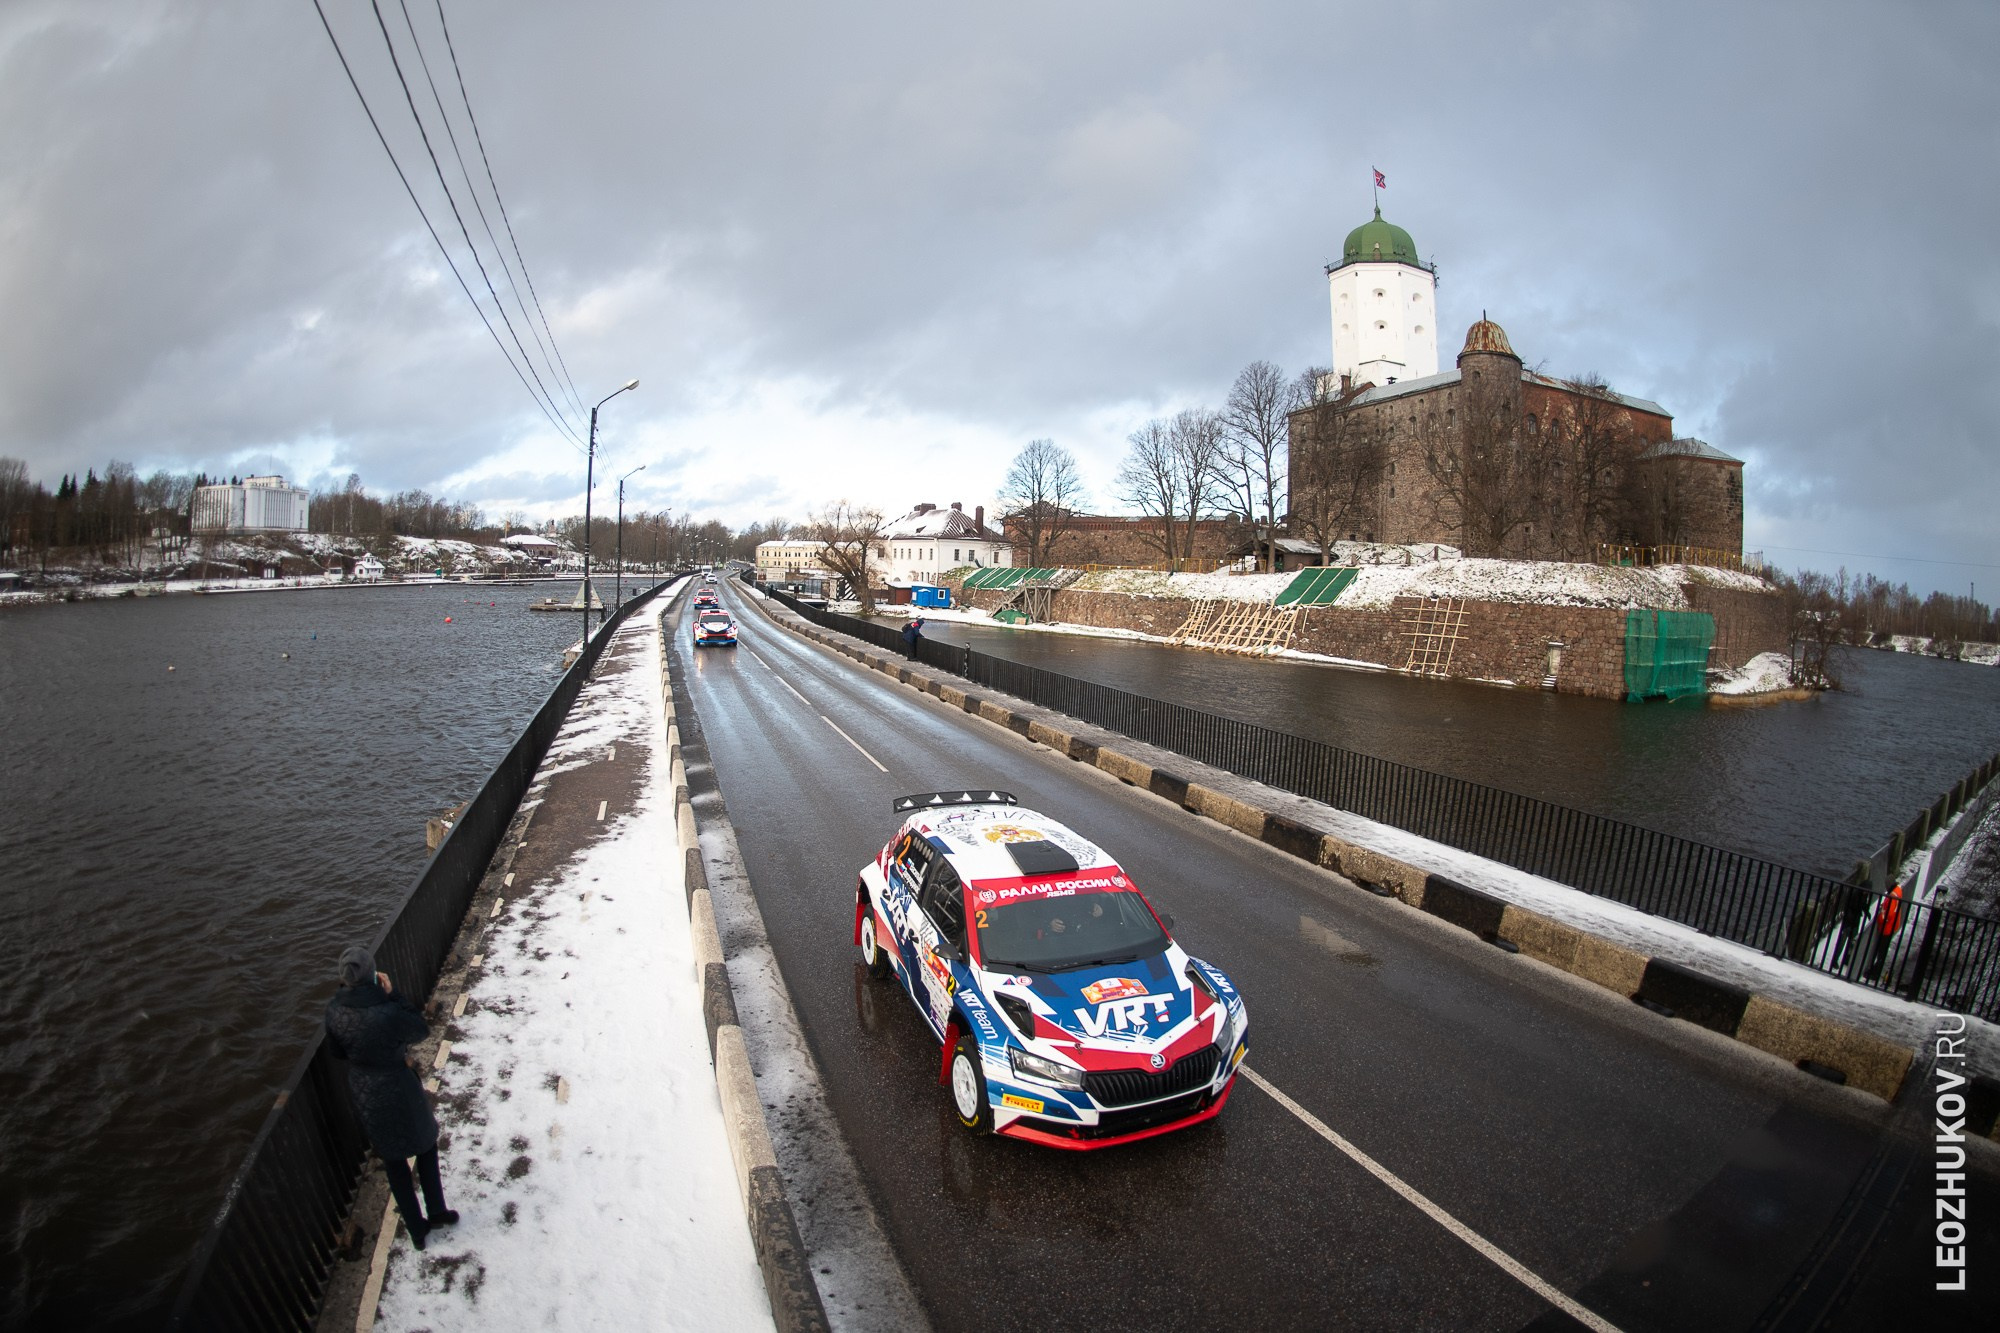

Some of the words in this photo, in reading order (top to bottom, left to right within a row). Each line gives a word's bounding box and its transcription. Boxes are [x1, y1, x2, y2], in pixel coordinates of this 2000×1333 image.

[896, 835, 912, 866] 2
[999, 883, 1053, 898] РАЛЛИ
[1055, 878, 1112, 891] РОССИИ
[975, 910, 989, 929] 2
[947, 975, 956, 997] 2
[1121, 986, 1138, 996] 24
[1205, 971, 1234, 993] VRT
[958, 987, 985, 1012] VRT
[971, 1009, 999, 1040] team
[1073, 992, 1175, 1038] VRT
